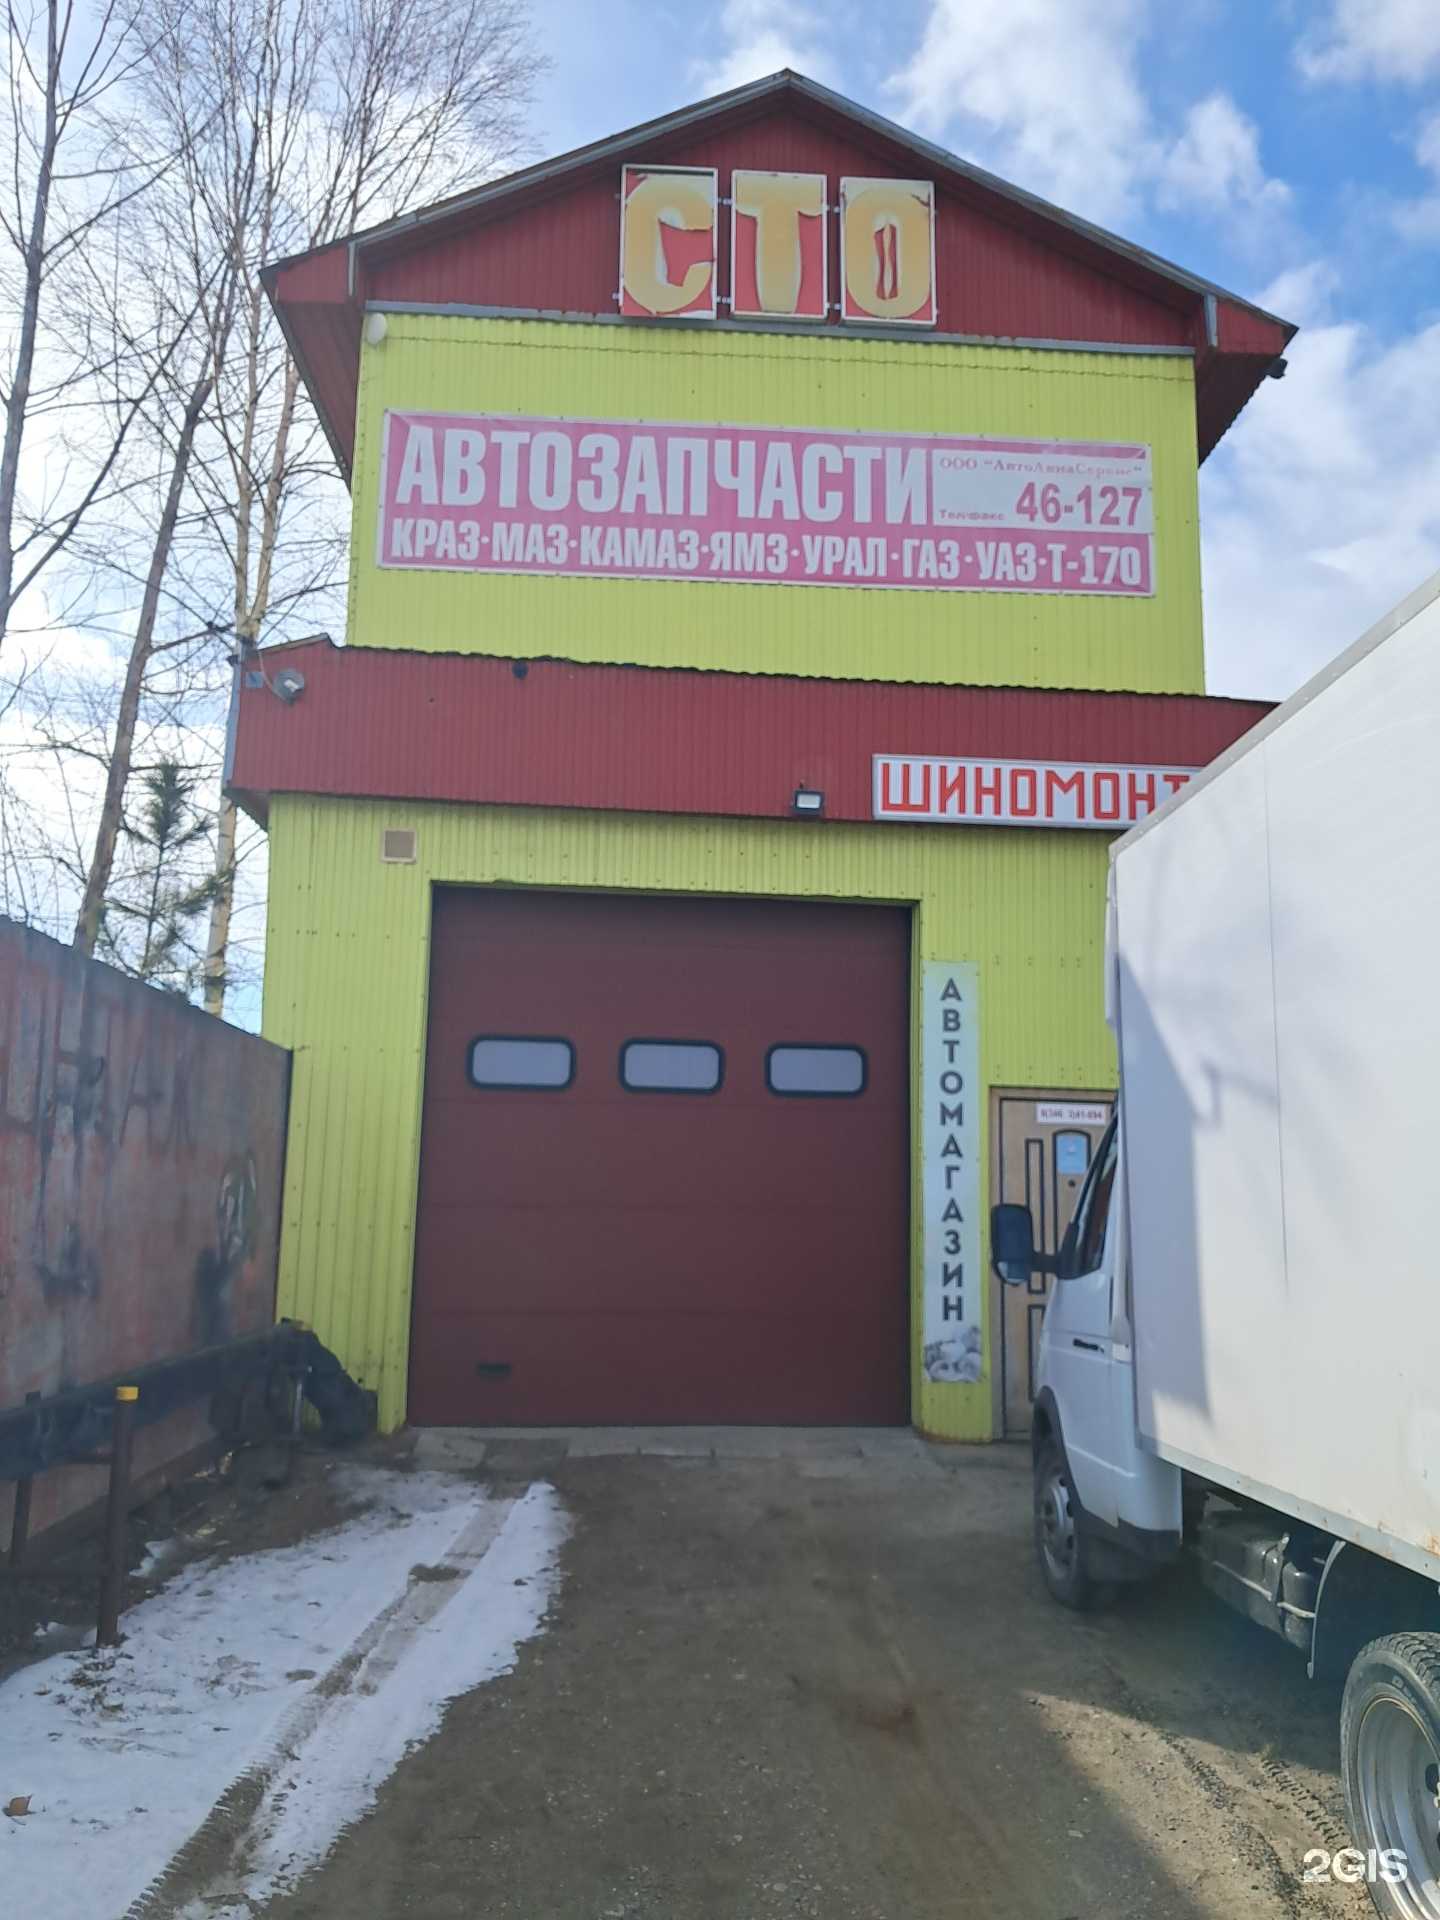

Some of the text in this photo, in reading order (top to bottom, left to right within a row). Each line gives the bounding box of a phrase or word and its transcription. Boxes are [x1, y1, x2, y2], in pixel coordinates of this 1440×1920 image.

[623, 172, 932, 319] СТО
[395, 424, 927, 525] АВТОЗАПЧАСТИ
[939, 457, 977, 470] ООО
[1016, 481, 1142, 526] 46-127
[940, 977, 964, 1321] АВТОМАГАЗИН
